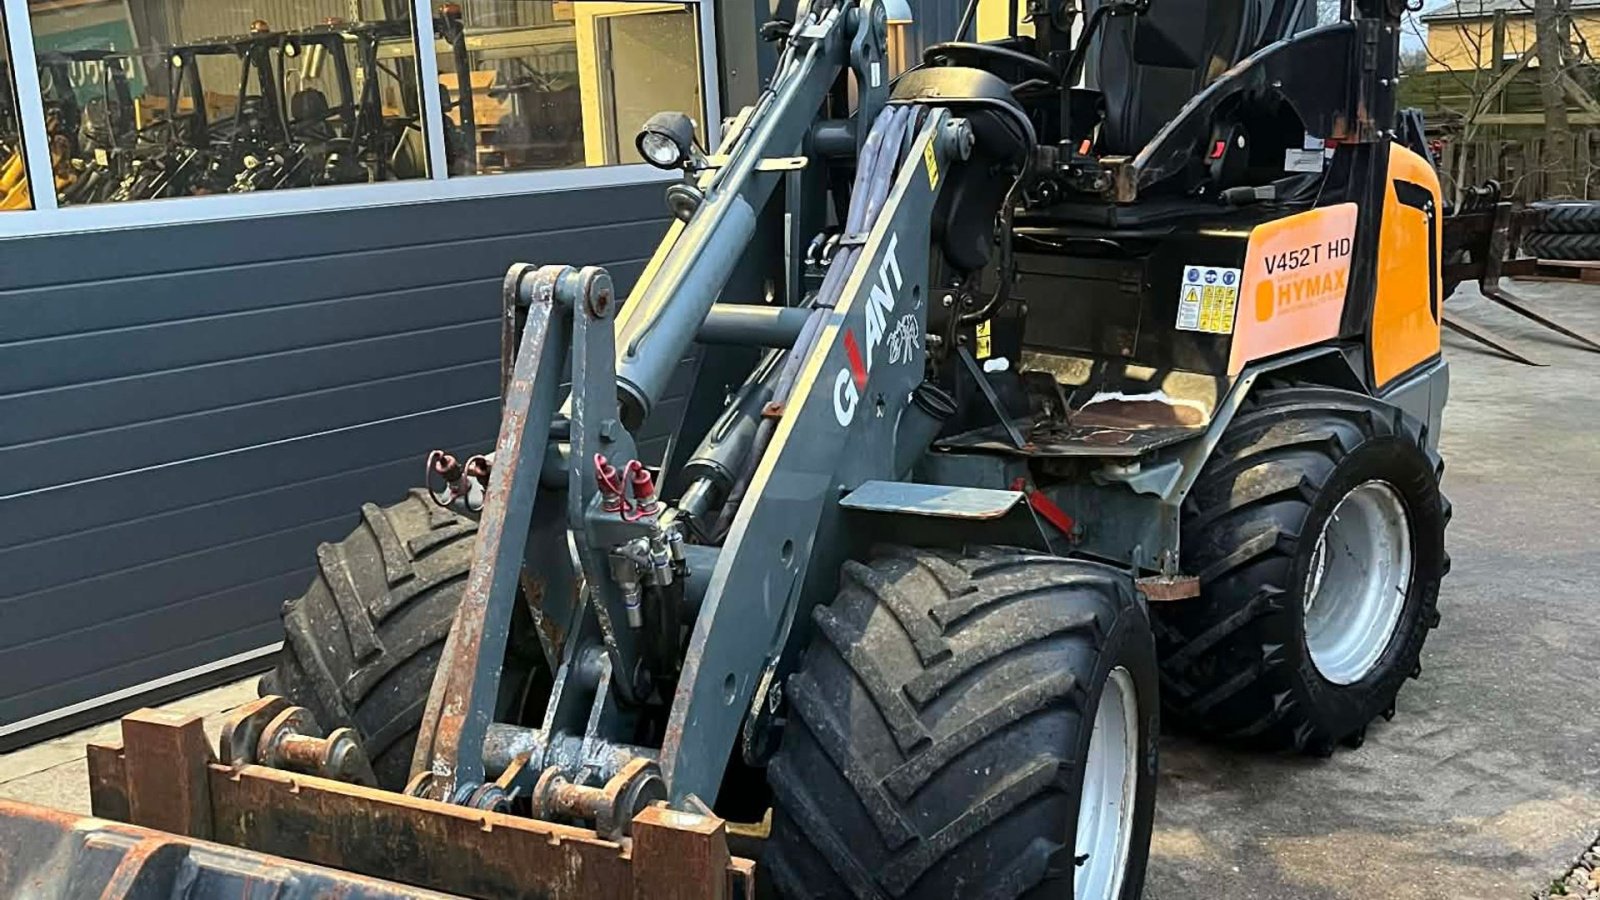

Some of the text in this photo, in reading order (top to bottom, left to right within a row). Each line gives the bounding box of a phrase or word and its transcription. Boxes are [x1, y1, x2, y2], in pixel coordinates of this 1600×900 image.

[1264, 237, 1351, 275] V452T HD
[1278, 267, 1346, 307] HYMAX
[833, 231, 904, 427] GIANT
